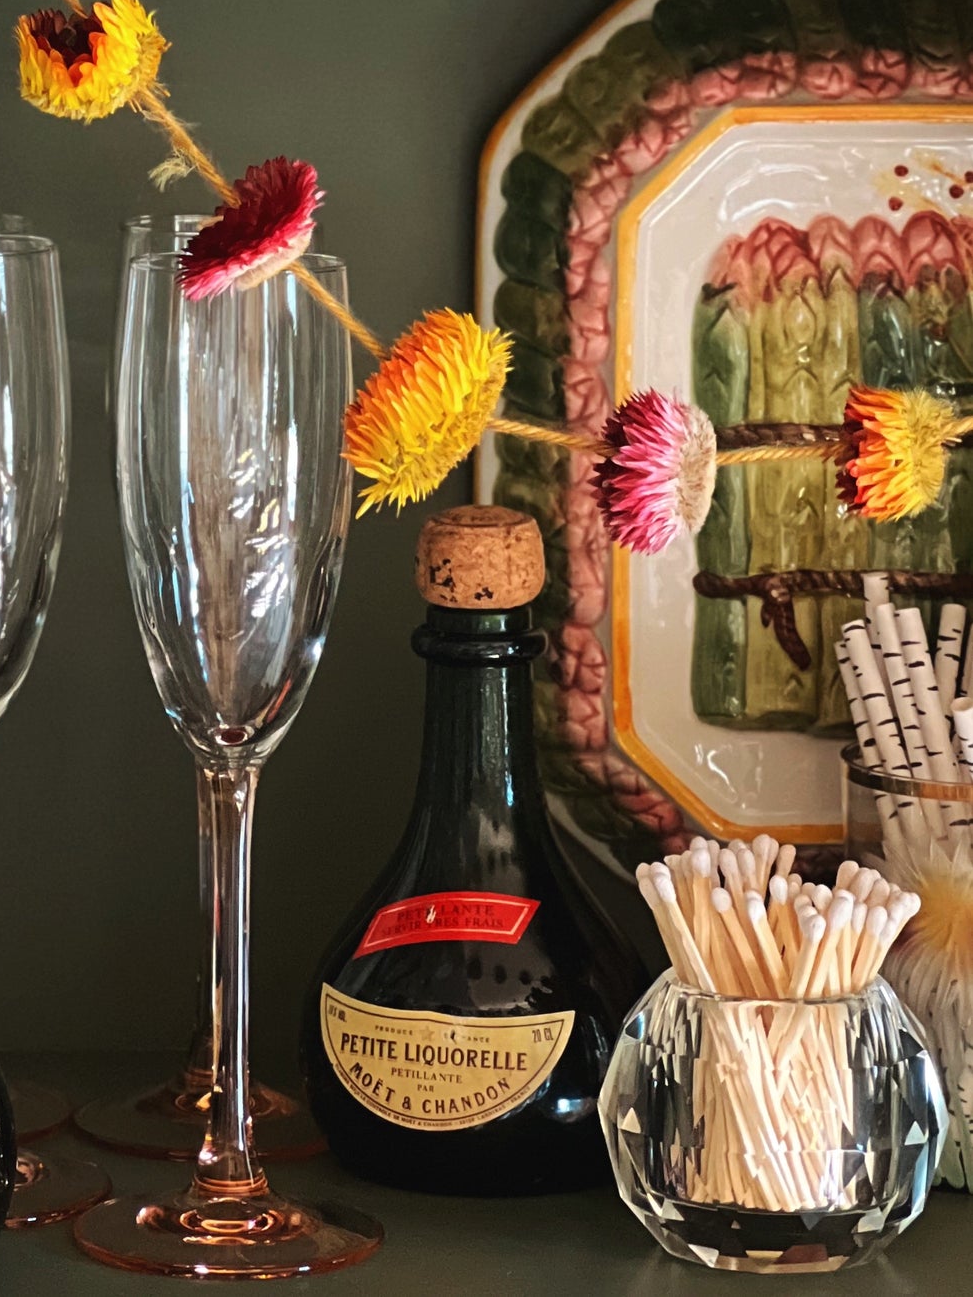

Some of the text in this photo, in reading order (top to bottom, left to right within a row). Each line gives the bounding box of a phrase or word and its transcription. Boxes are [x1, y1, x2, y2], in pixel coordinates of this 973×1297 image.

[397, 905, 495, 922] PETILANTE
[465, 917, 504, 928] FRAIS
[532, 1030, 541, 1043] 20
[340, 1032, 527, 1071] PETITE LIQUORELLE
[391, 1067, 462, 1083] PETILLANTE
[350, 1062, 510, 1114] MOËT & CHANDON
[417, 1084, 434, 1093] PAR
